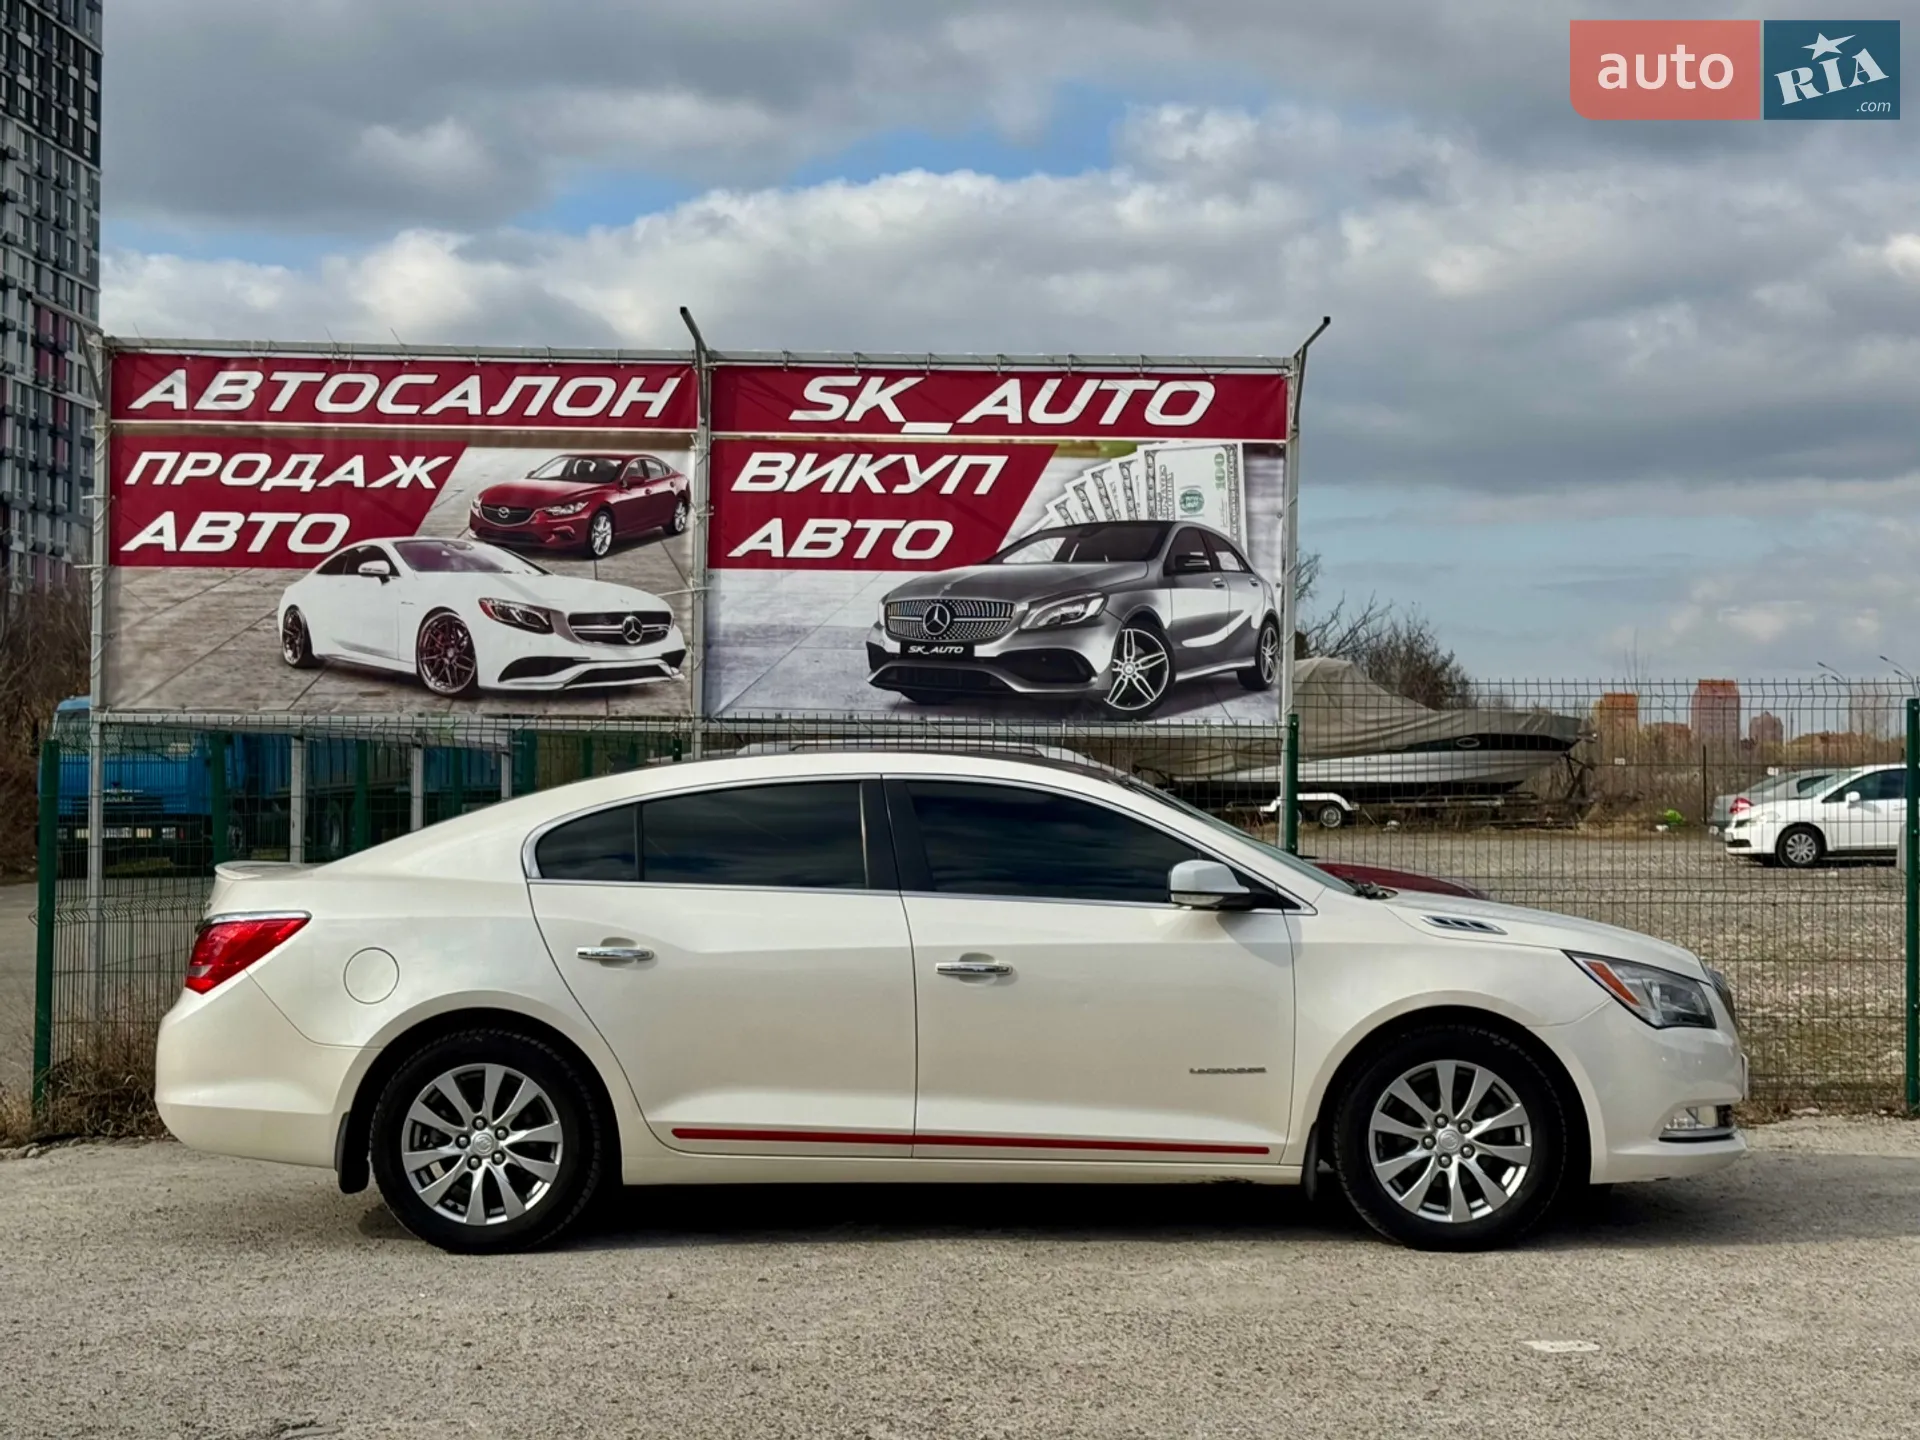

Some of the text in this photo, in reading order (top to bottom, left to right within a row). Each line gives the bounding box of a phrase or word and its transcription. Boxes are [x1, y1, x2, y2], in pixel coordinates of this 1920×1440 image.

[128, 368, 682, 419] АВТОСАЛОН
[789, 375, 1216, 434] SK_AUTO
[125, 451, 452, 493] ПРОДАЖ
[731, 452, 1009, 495] ВИКУП
[120, 510, 351, 553] АВТО
[727, 517, 954, 560] АВТО
[907, 645, 964, 655] SK_AUTO
